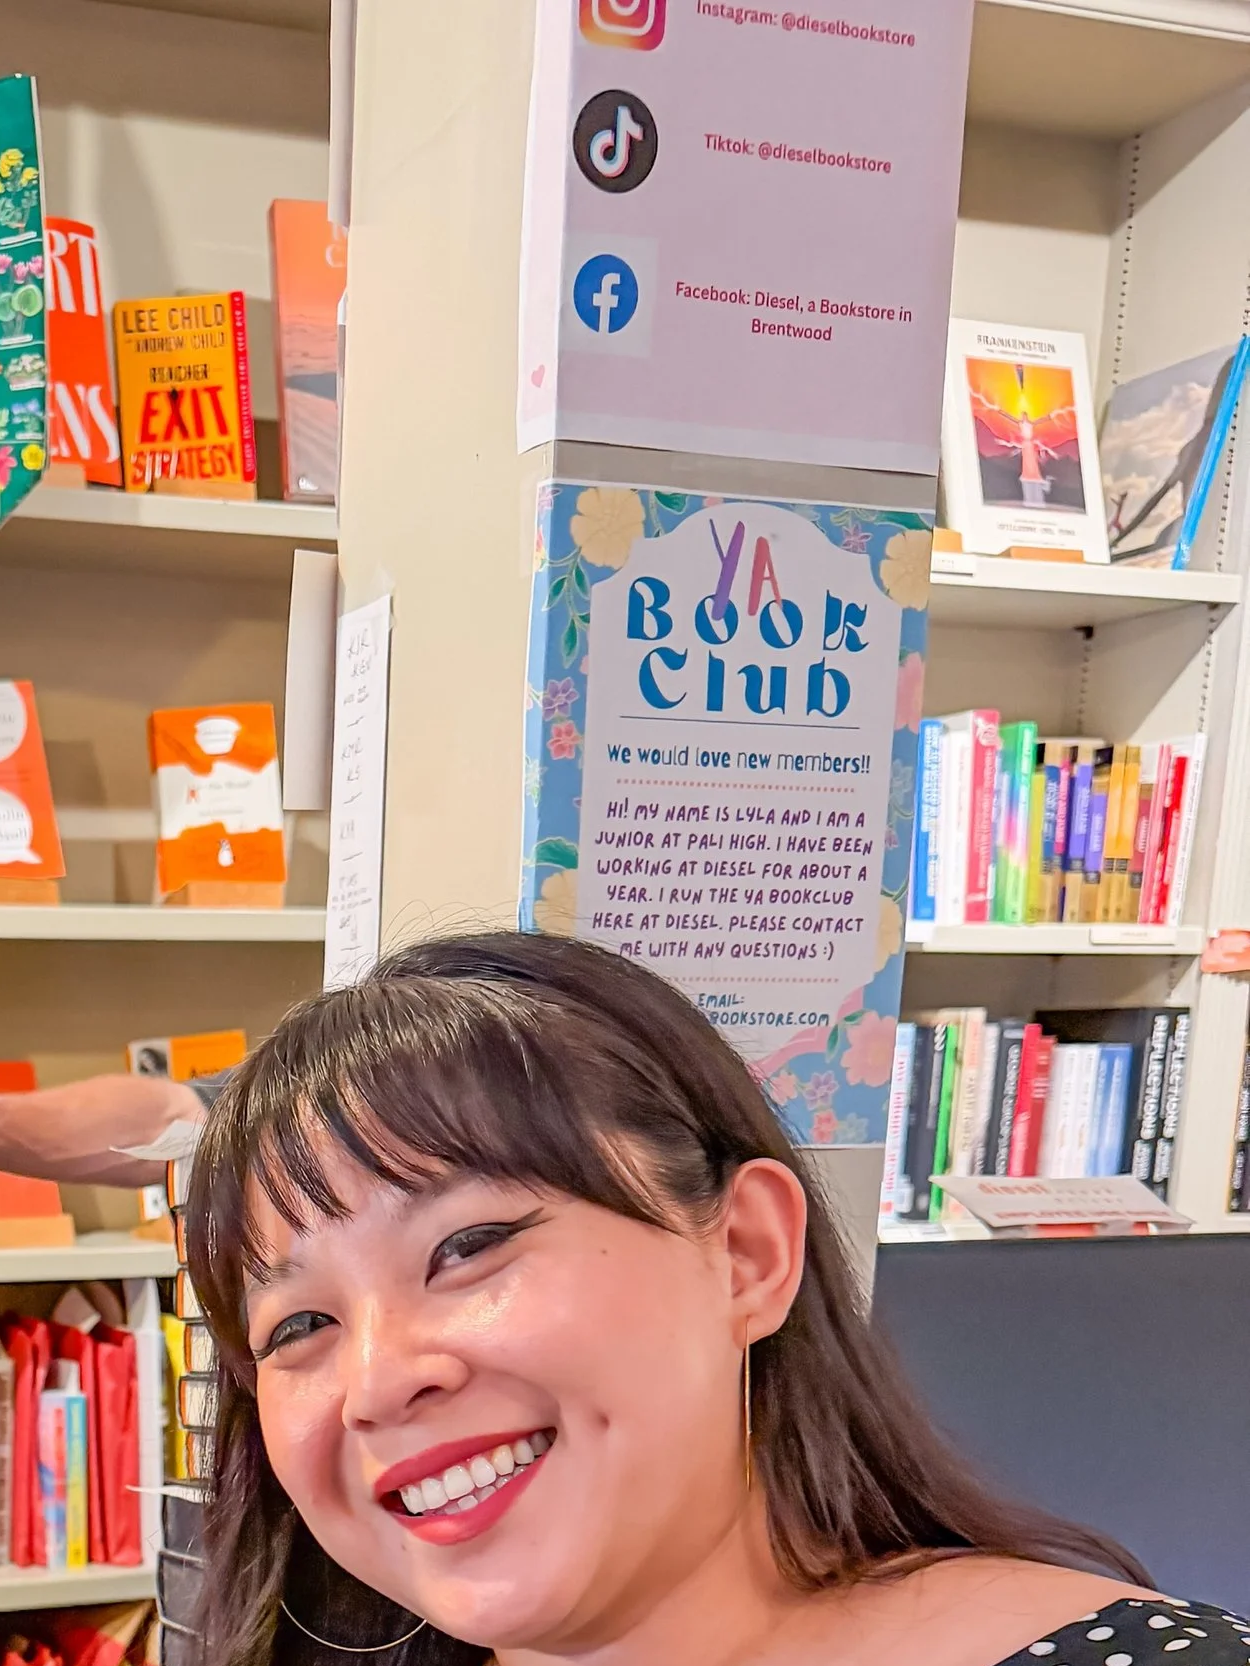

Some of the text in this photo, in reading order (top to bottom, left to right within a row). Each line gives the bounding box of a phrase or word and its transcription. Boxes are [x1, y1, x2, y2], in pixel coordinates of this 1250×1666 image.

[696, 1, 915, 47] Instagram: @dieselbookstore
[704, 133, 892, 174] Tiktok: @dieselbookstore
[676, 281, 912, 323] Facebook: Diesel, a Bookstore in
[122, 303, 225, 334] LEE CHILD
[751, 318, 833, 341] Brentwood
[191, 331, 225, 350] CHILD
[977, 334, 1056, 353] FRANKENSTEIN
[139, 385, 230, 444] EXIT
[130, 441, 239, 485] STRATEGY
[710, 518, 783, 620] YA
[607, 743, 870, 774] We would love new members!!
[606, 797, 865, 828] HI! MY NAME IS LYLA AND I AM A
[595, 831, 873, 855] JUNIOR AT PALI HIGH. I HAVE BEEN
[597, 859, 867, 881] WORKING AT DIESEL FOR ABOUT A
[606, 885, 854, 906] YEAR. I RUN THE YA BOOKCLUB
[592, 912, 864, 933] HERE AT DIESEL. PLEASE CONTACT
[620, 940, 642, 957] ME
[649, 941, 688, 957] WITH
[695, 942, 724, 959] ANY
[731, 942, 817, 960] QUESTIONS
[698, 993, 745, 1008] EMAIL:
